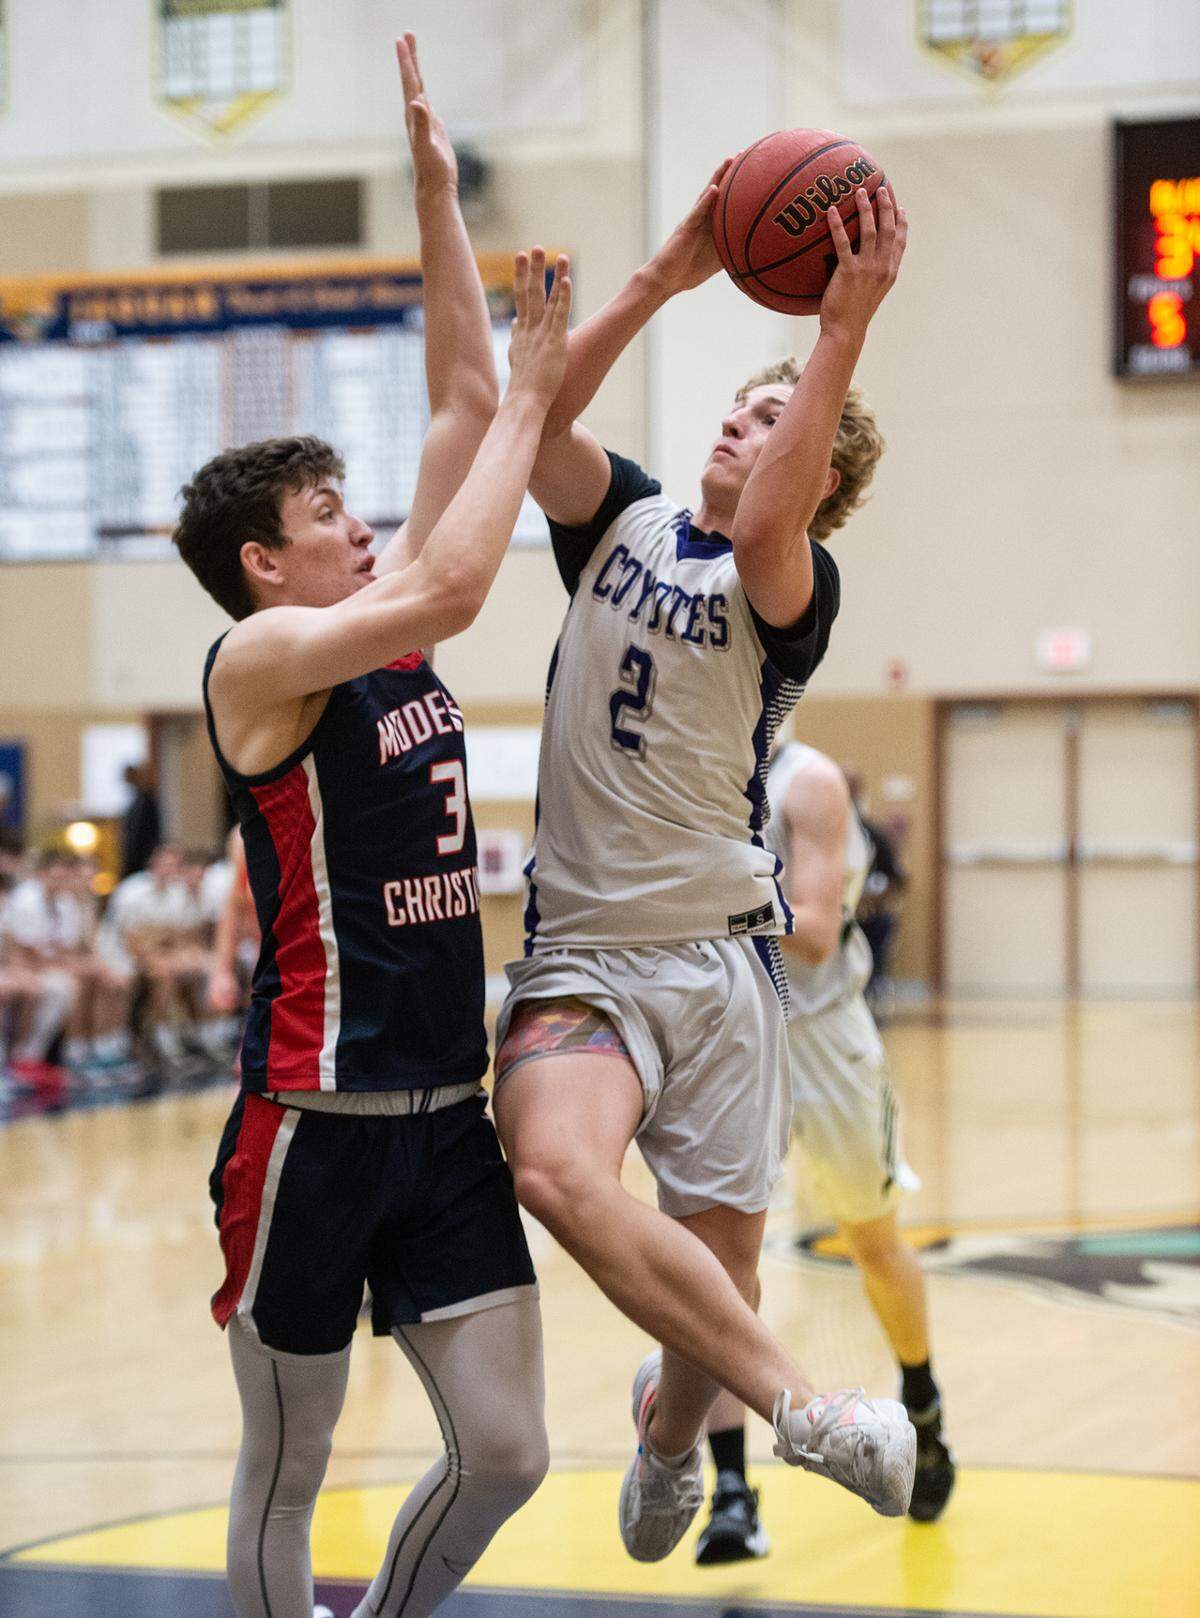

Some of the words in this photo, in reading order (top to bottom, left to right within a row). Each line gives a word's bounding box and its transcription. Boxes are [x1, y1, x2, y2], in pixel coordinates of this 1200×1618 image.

[772, 157, 877, 236] Wilson
[592, 544, 731, 652] COYOTES
[609, 641, 659, 764] 2
[428, 759, 467, 857] 3
